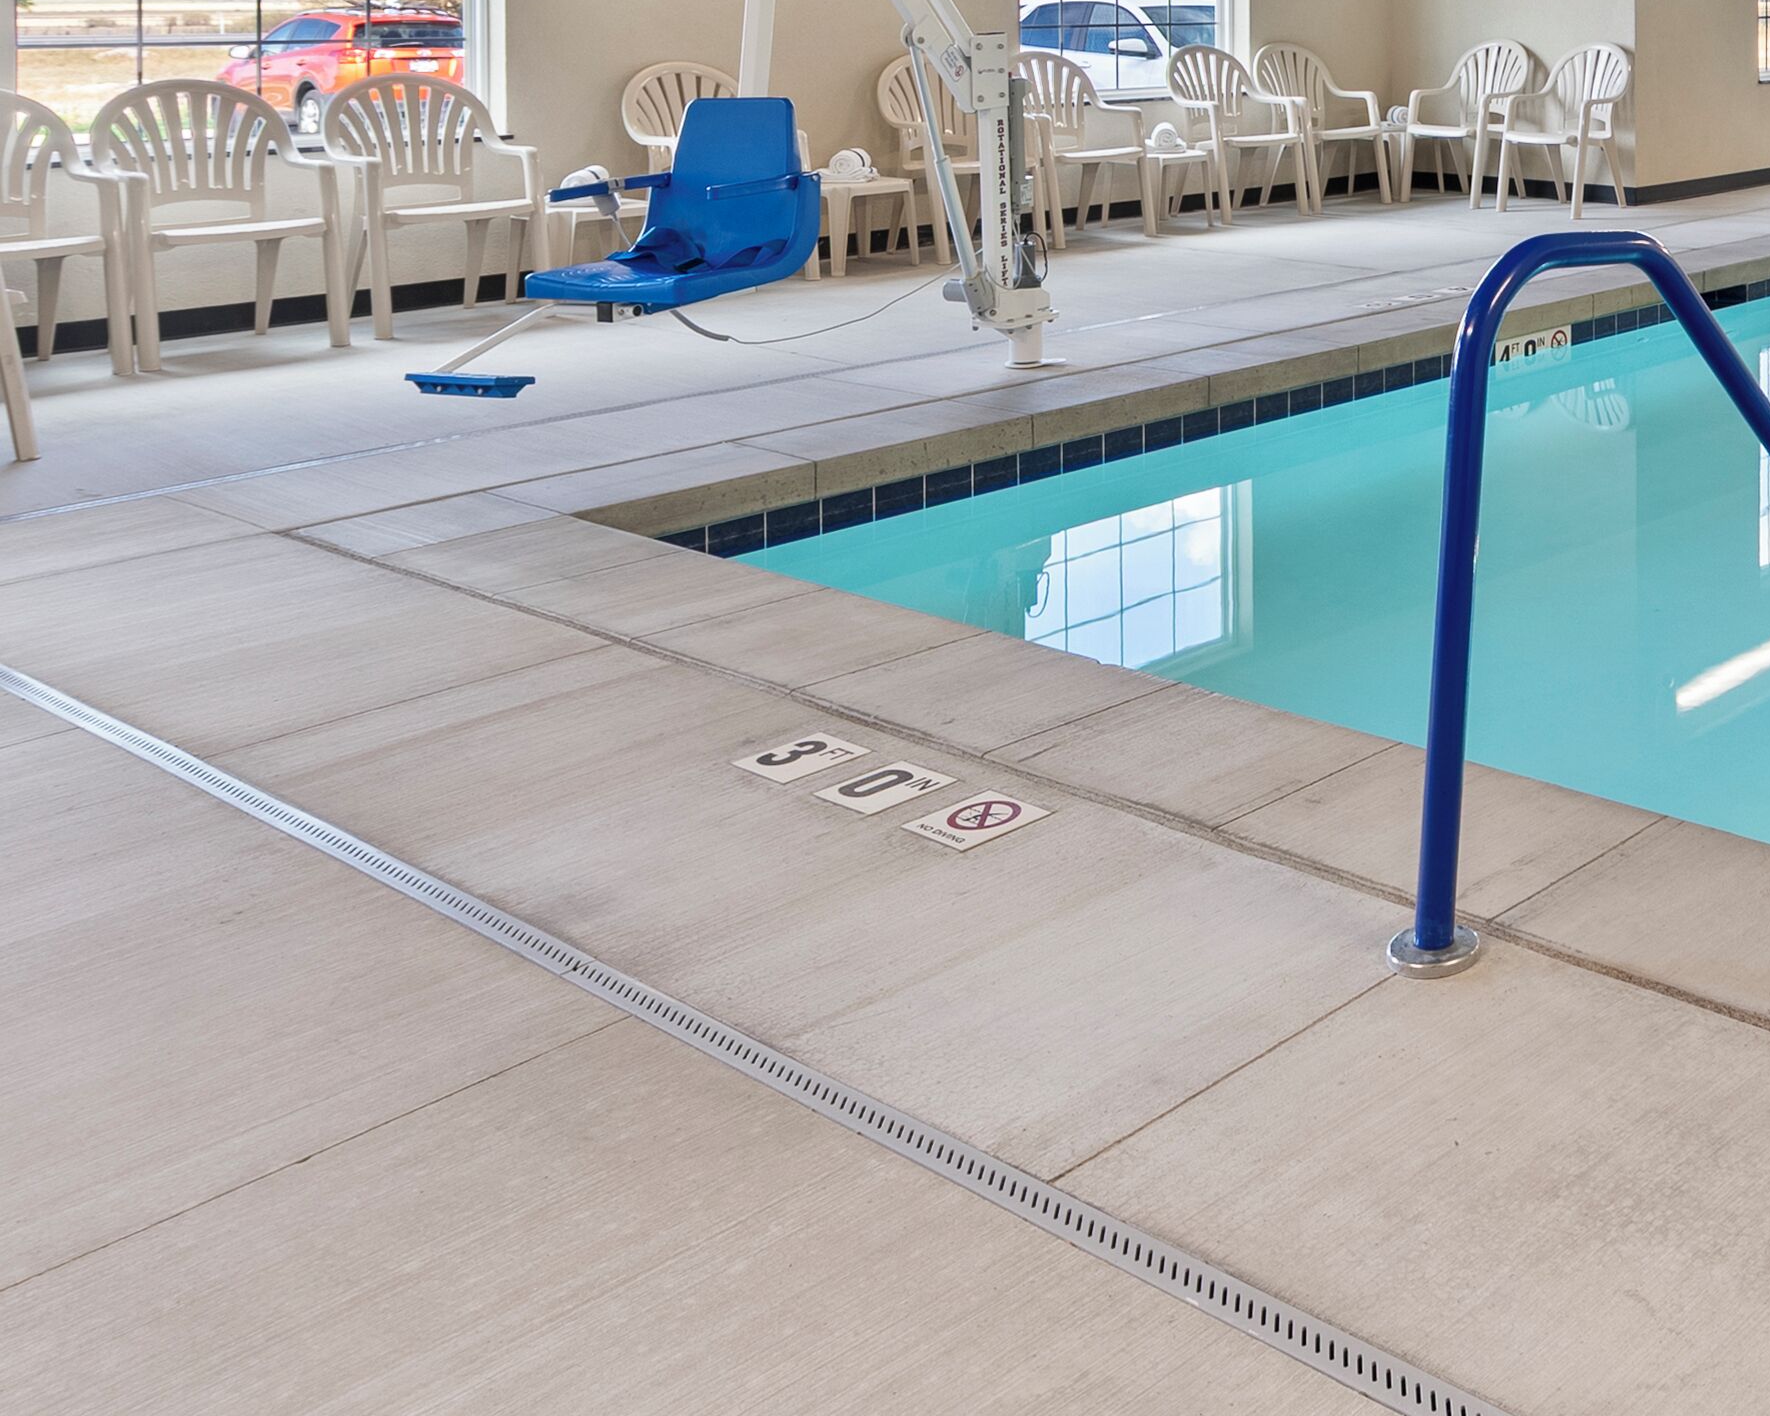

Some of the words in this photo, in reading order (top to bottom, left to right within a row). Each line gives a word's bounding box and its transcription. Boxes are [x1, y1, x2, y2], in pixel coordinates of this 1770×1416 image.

[997, 119, 1006, 195] ROTATIONAL
[1001, 255, 1009, 286] LIFT
[756, 740, 828, 766] 3
[819, 747, 855, 761] FT
[904, 777, 940, 791] IN
[917, 823, 934, 831] NO
[931, 829, 966, 844] DIVING
